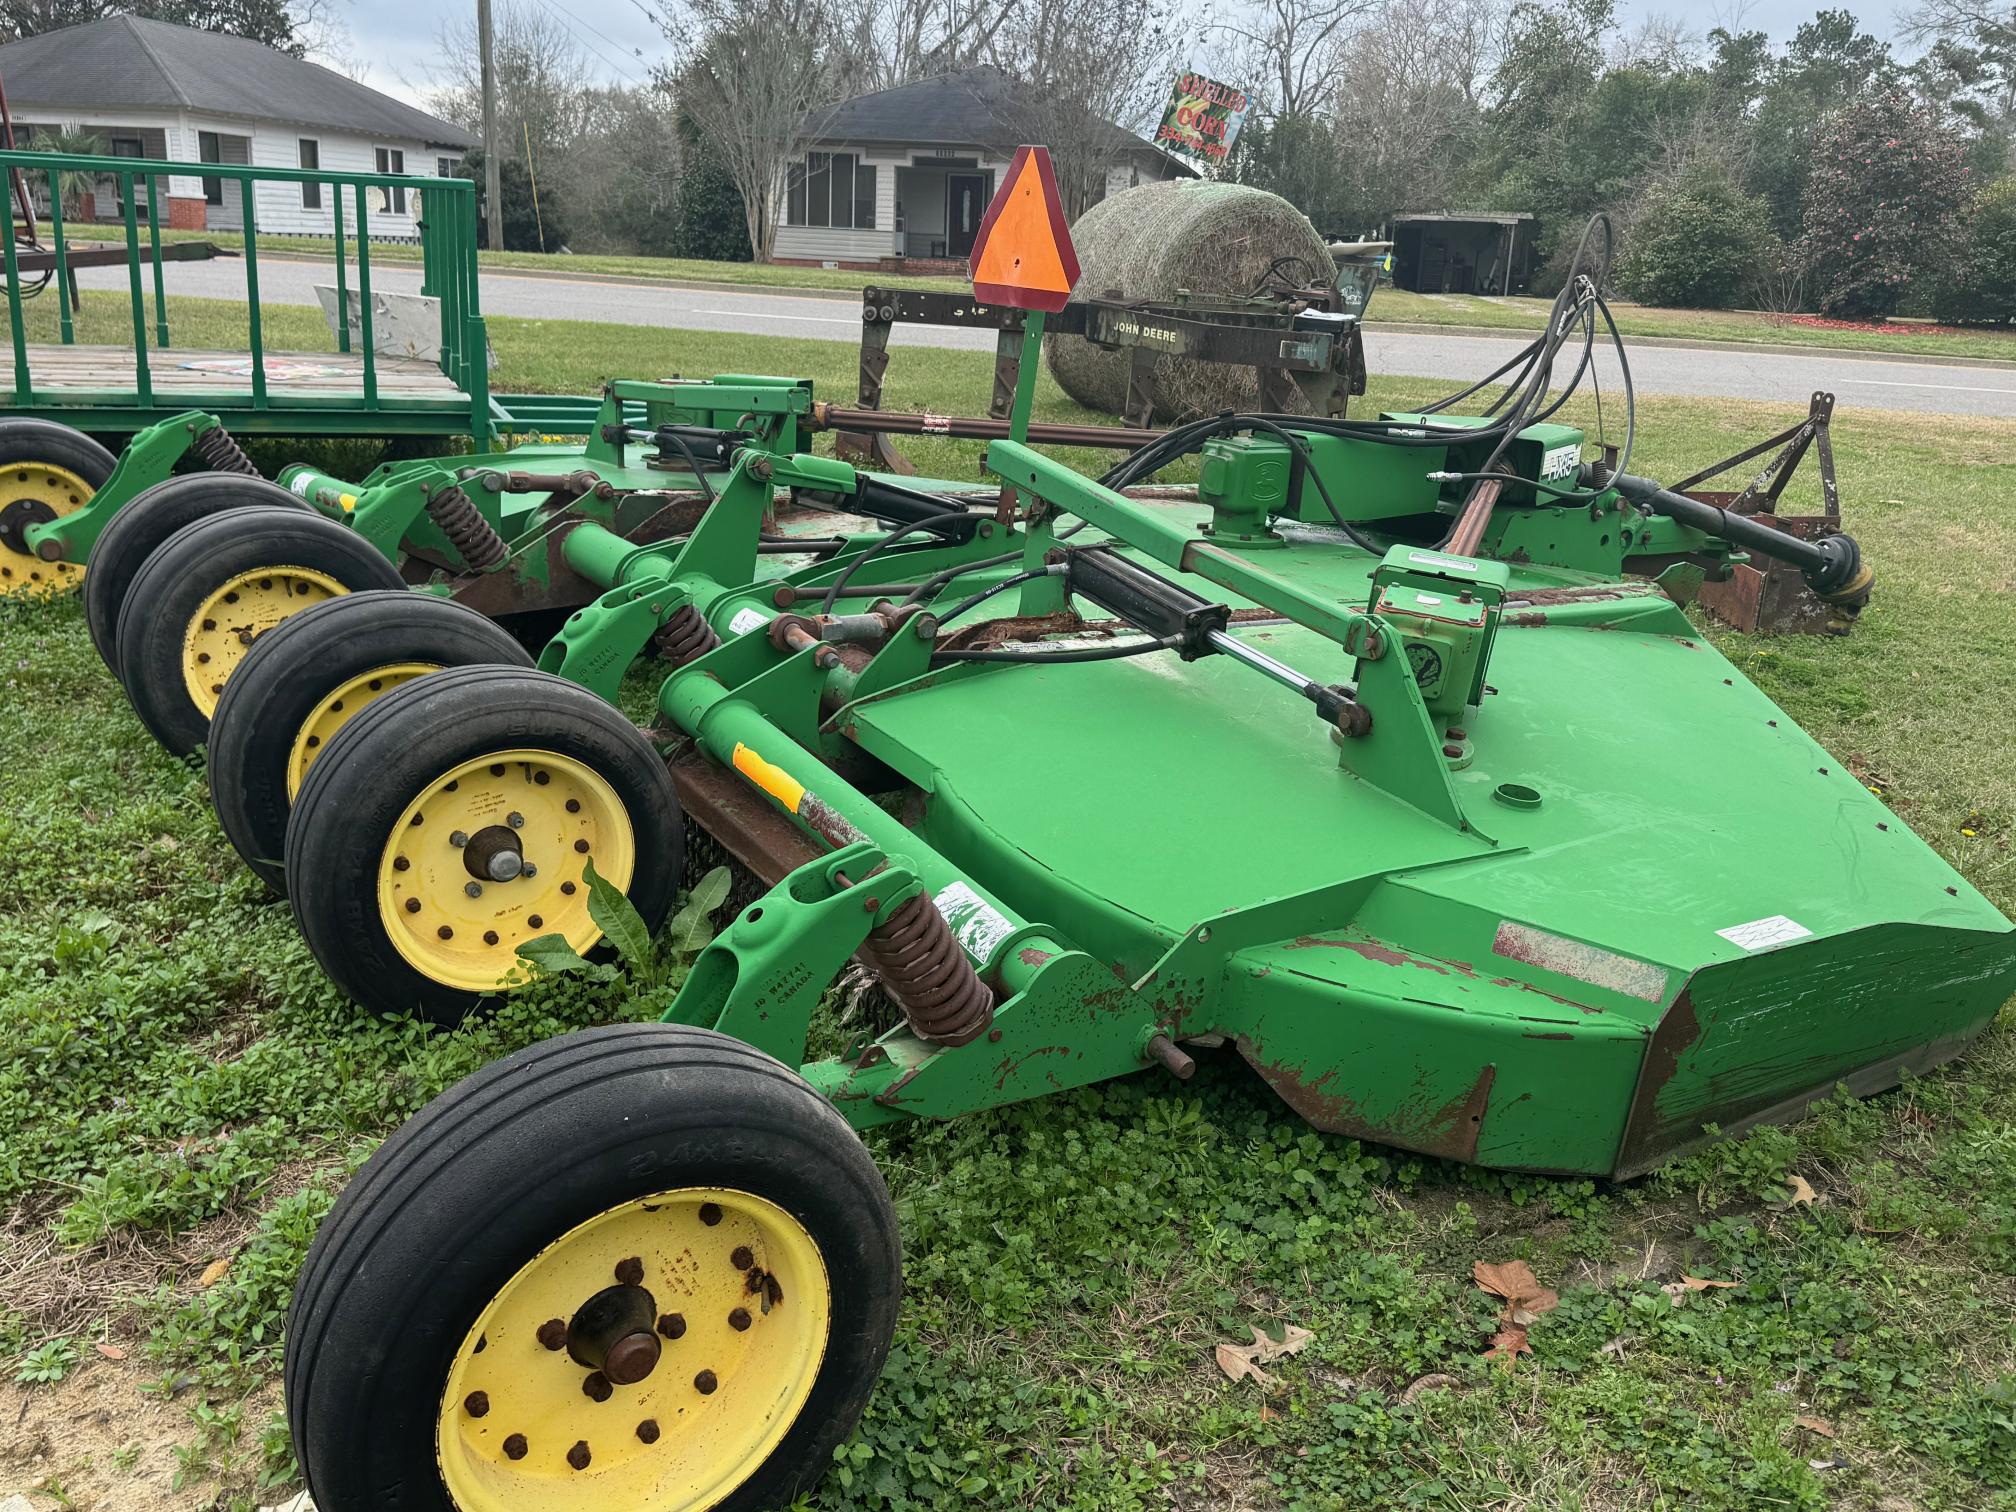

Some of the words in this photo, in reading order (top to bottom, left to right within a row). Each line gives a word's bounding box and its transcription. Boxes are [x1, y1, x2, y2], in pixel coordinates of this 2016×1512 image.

[1179, 74, 1247, 113] SHELLED
[1176, 106, 1230, 141] CORN
[1113, 321, 1140, 336] JOHN
[1143, 326, 1177, 343] DEERE
[1548, 452, 1575, 482] HX15
[777, 971, 815, 1006] CANADA
